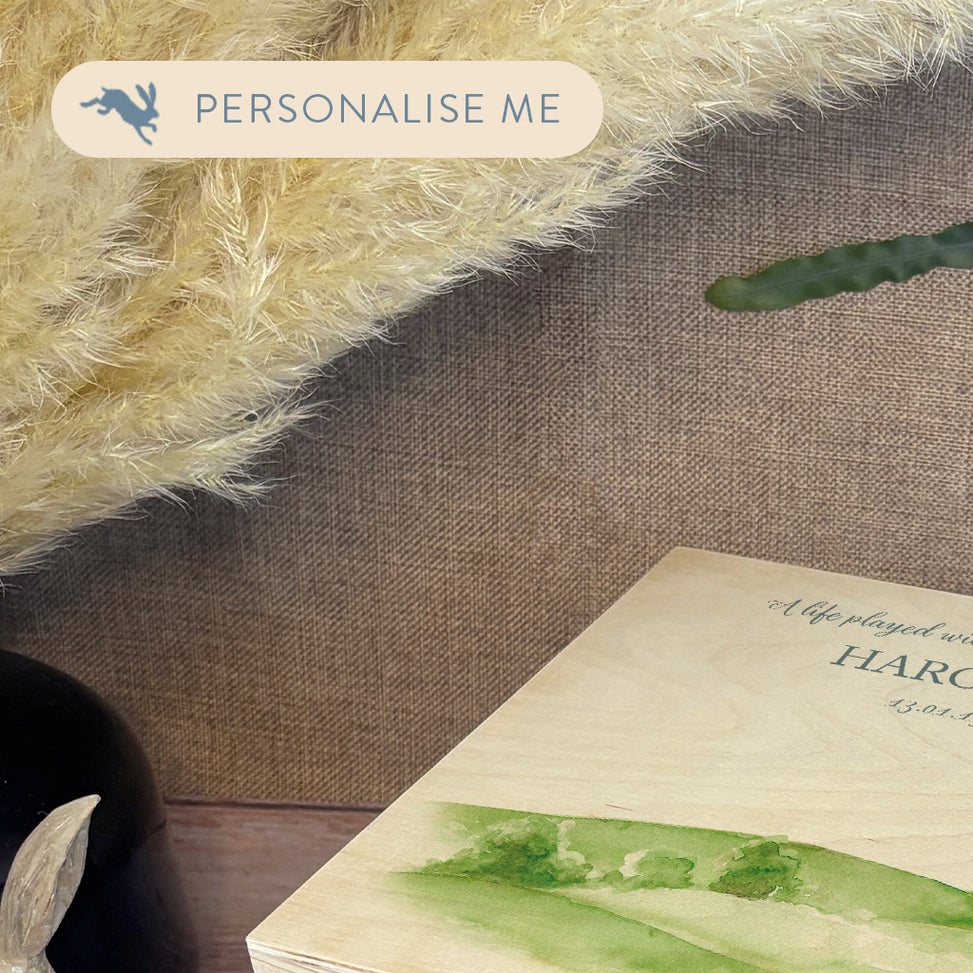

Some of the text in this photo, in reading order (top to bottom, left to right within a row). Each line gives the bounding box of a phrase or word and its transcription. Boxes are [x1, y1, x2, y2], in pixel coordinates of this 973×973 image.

[768, 599, 802, 617] A
[800, 600, 843, 626] life
[838, 611, 946, 638] played
